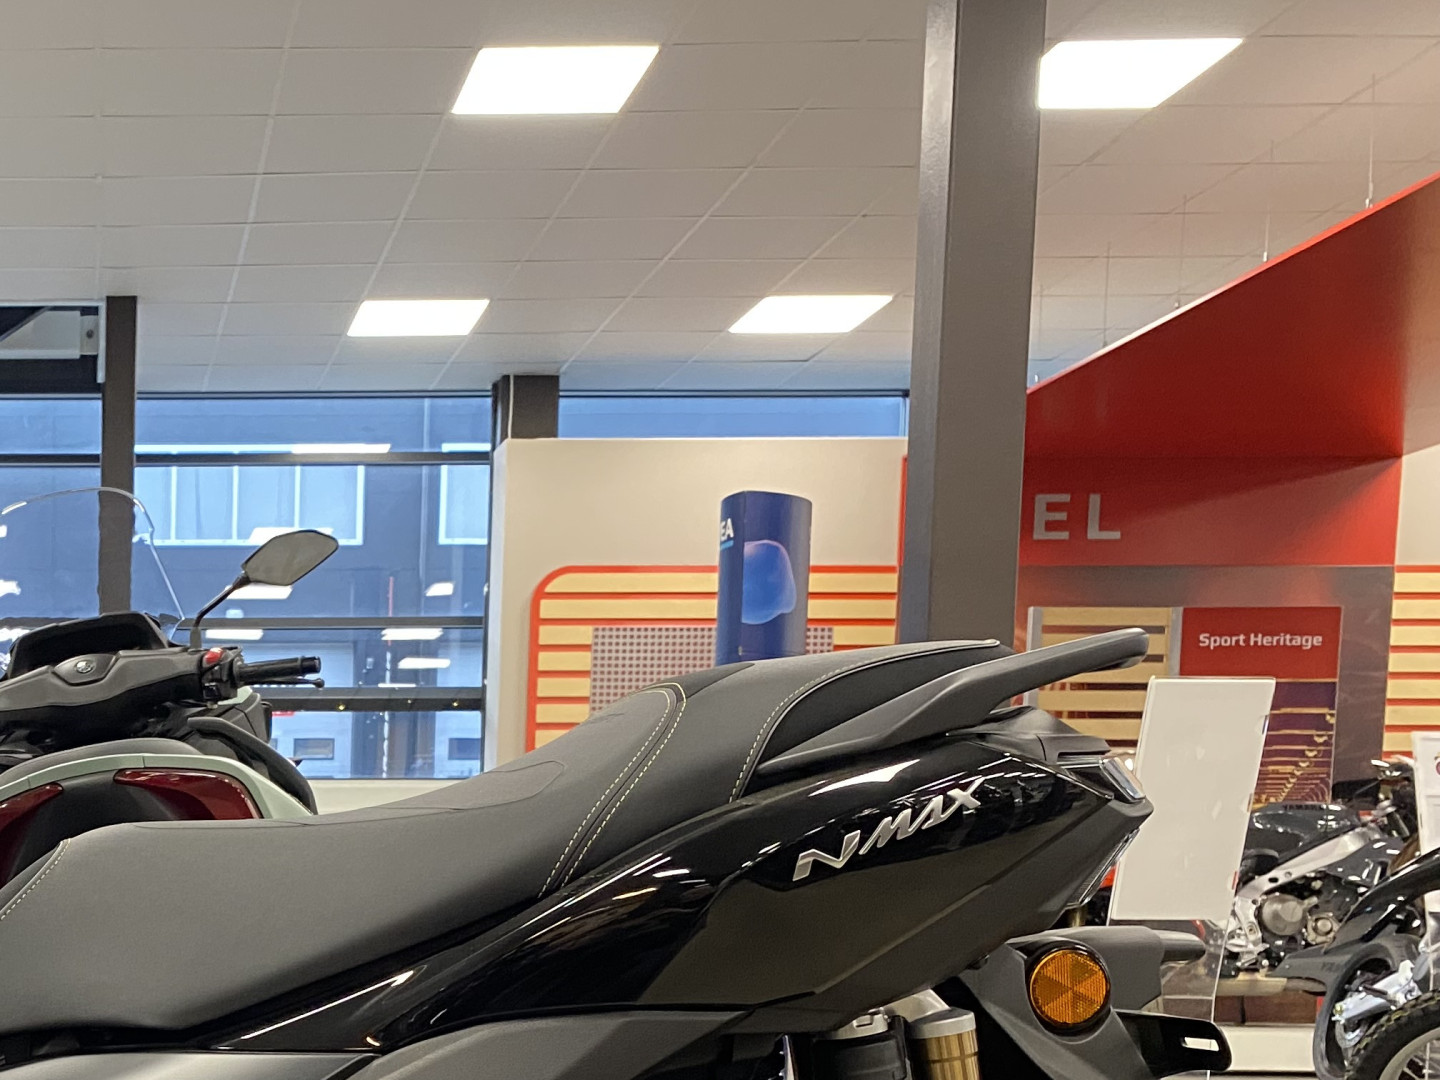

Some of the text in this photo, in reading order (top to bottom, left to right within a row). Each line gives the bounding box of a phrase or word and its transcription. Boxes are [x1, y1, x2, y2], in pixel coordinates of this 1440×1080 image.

[1198, 632, 1323, 650] Sport Heritage
[792, 778, 985, 882] NMAX
